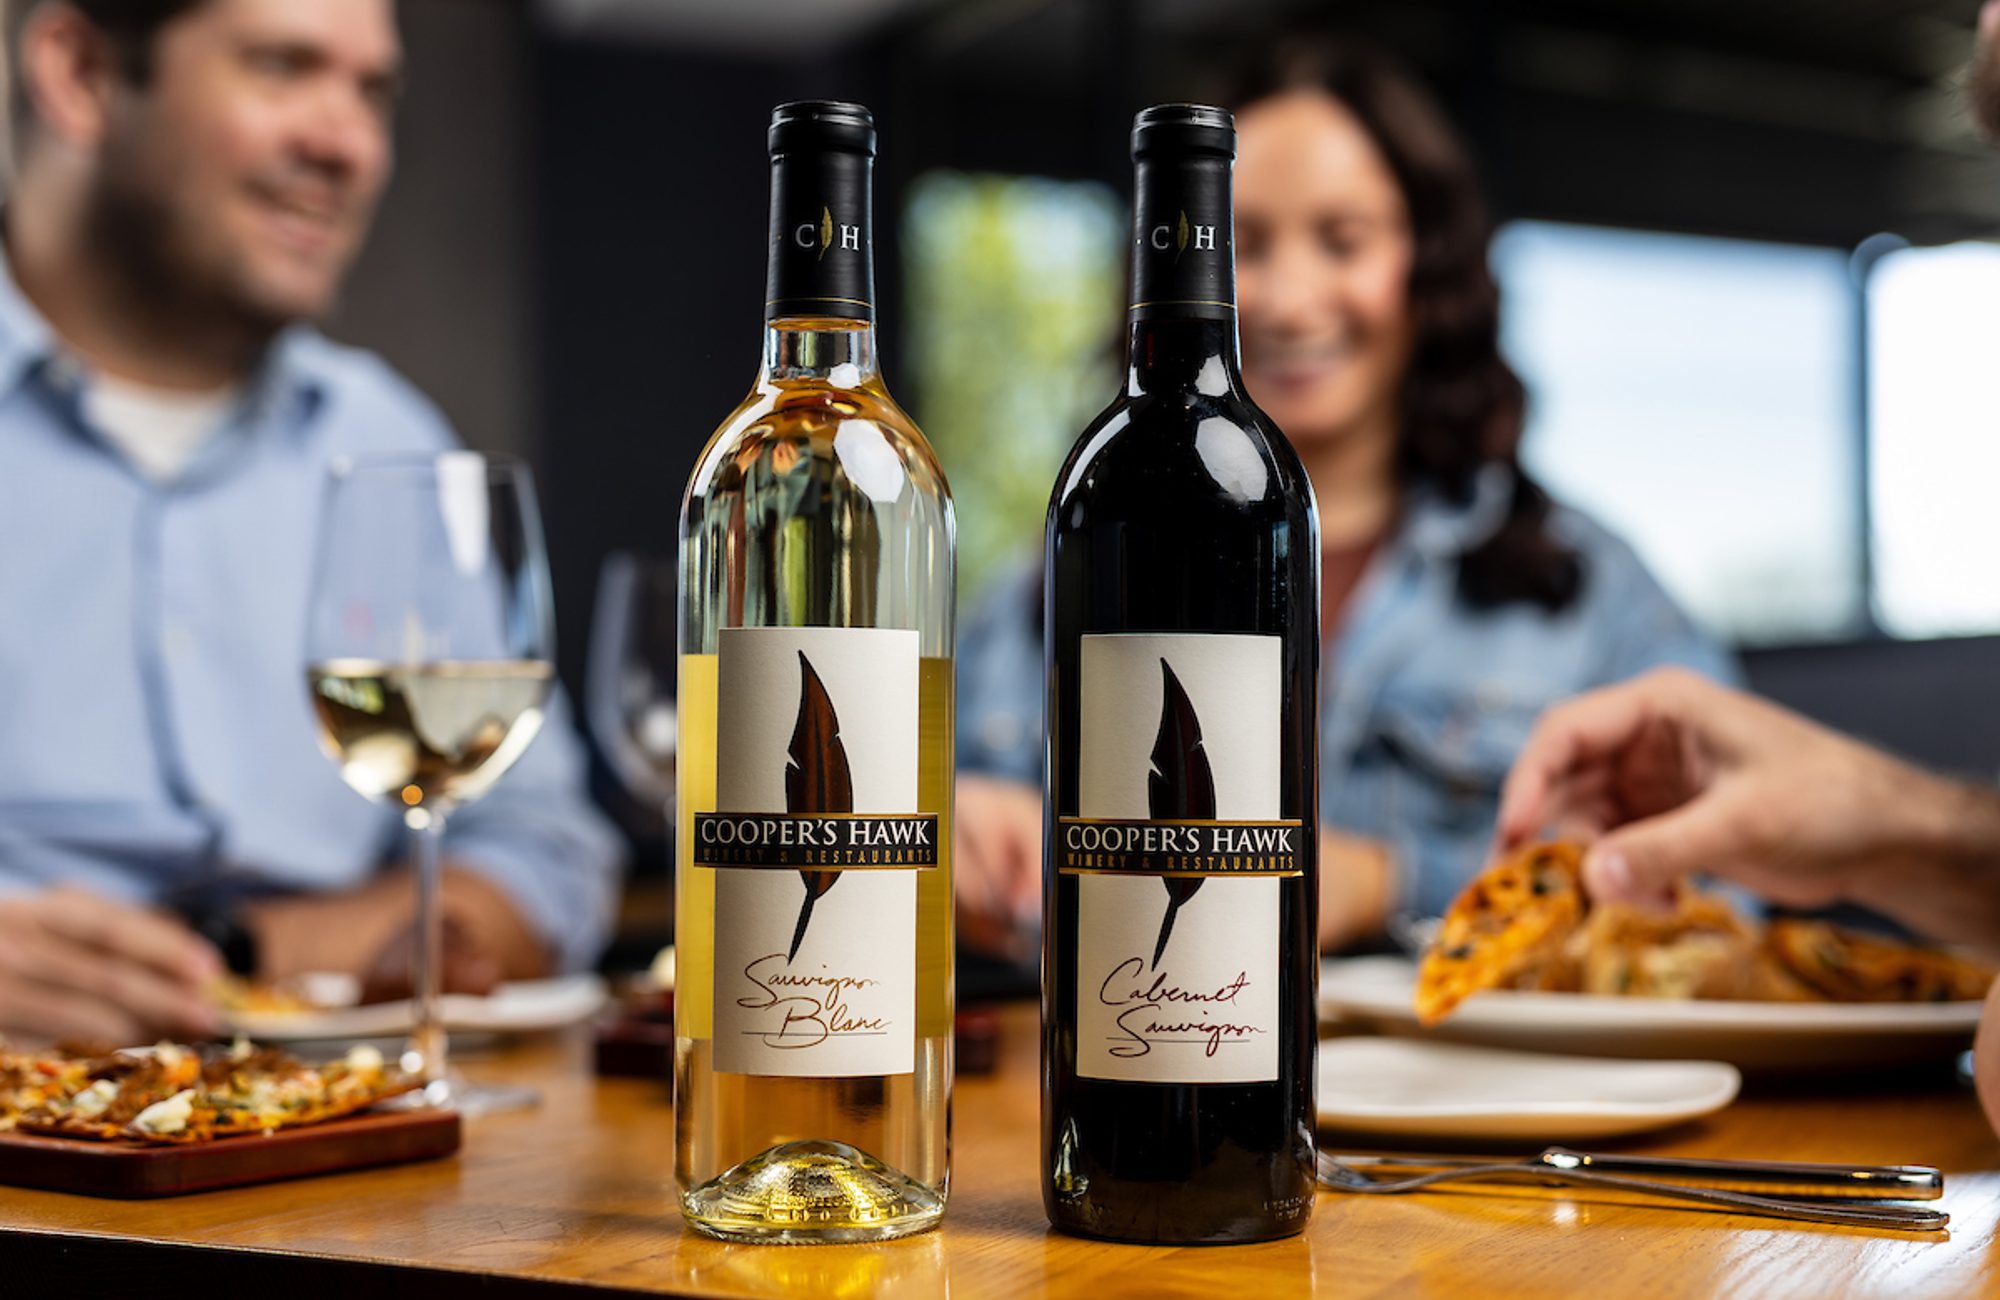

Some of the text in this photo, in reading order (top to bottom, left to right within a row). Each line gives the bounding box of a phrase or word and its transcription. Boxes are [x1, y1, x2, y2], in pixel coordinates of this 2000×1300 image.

[795, 223, 860, 252] C H
[1151, 225, 1216, 250] C H
[701, 818, 930, 846] COOPER'S HAWK
[1066, 825, 1294, 854] COOPER'S HAWK
[805, 849, 932, 864] RESTAURANTS
[1067, 853, 1126, 868] WINERY
[1167, 855, 1294, 870] RESTAURANTS
[737, 953, 881, 1011] Sauvignon
[1100, 957, 1251, 1006] Cabernet
[763, 996, 892, 1049] Blanc
[1108, 1003, 1267, 1057] Sauvignon
